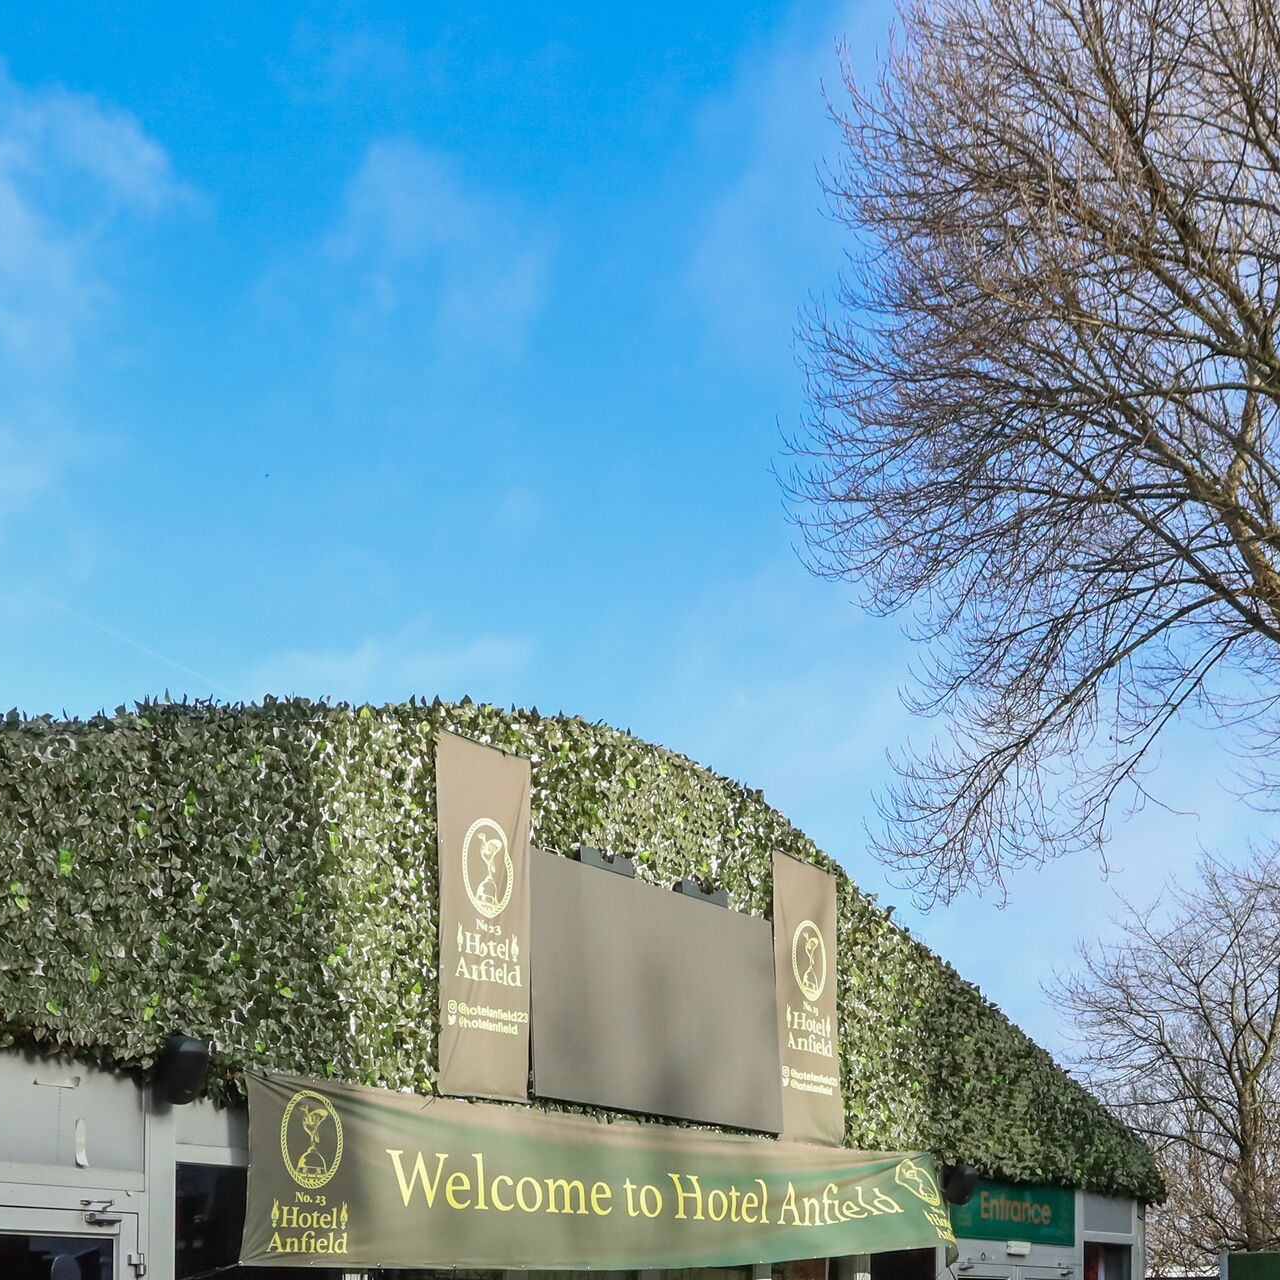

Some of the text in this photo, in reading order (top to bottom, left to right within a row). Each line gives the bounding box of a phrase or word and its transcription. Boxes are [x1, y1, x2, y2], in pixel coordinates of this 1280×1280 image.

[464, 931, 510, 961] Hotel
[792, 1011, 826, 1037] Hotel
[787, 1031, 833, 1058] Anfield
[295, 1191, 327, 1206] No. 23
[385, 1148, 905, 1227] Welcome to Hotel Anfield
[281, 1205, 339, 1230] Hotel
[979, 1190, 1053, 1226] Entrance
[266, 1230, 349, 1254] Anfield
